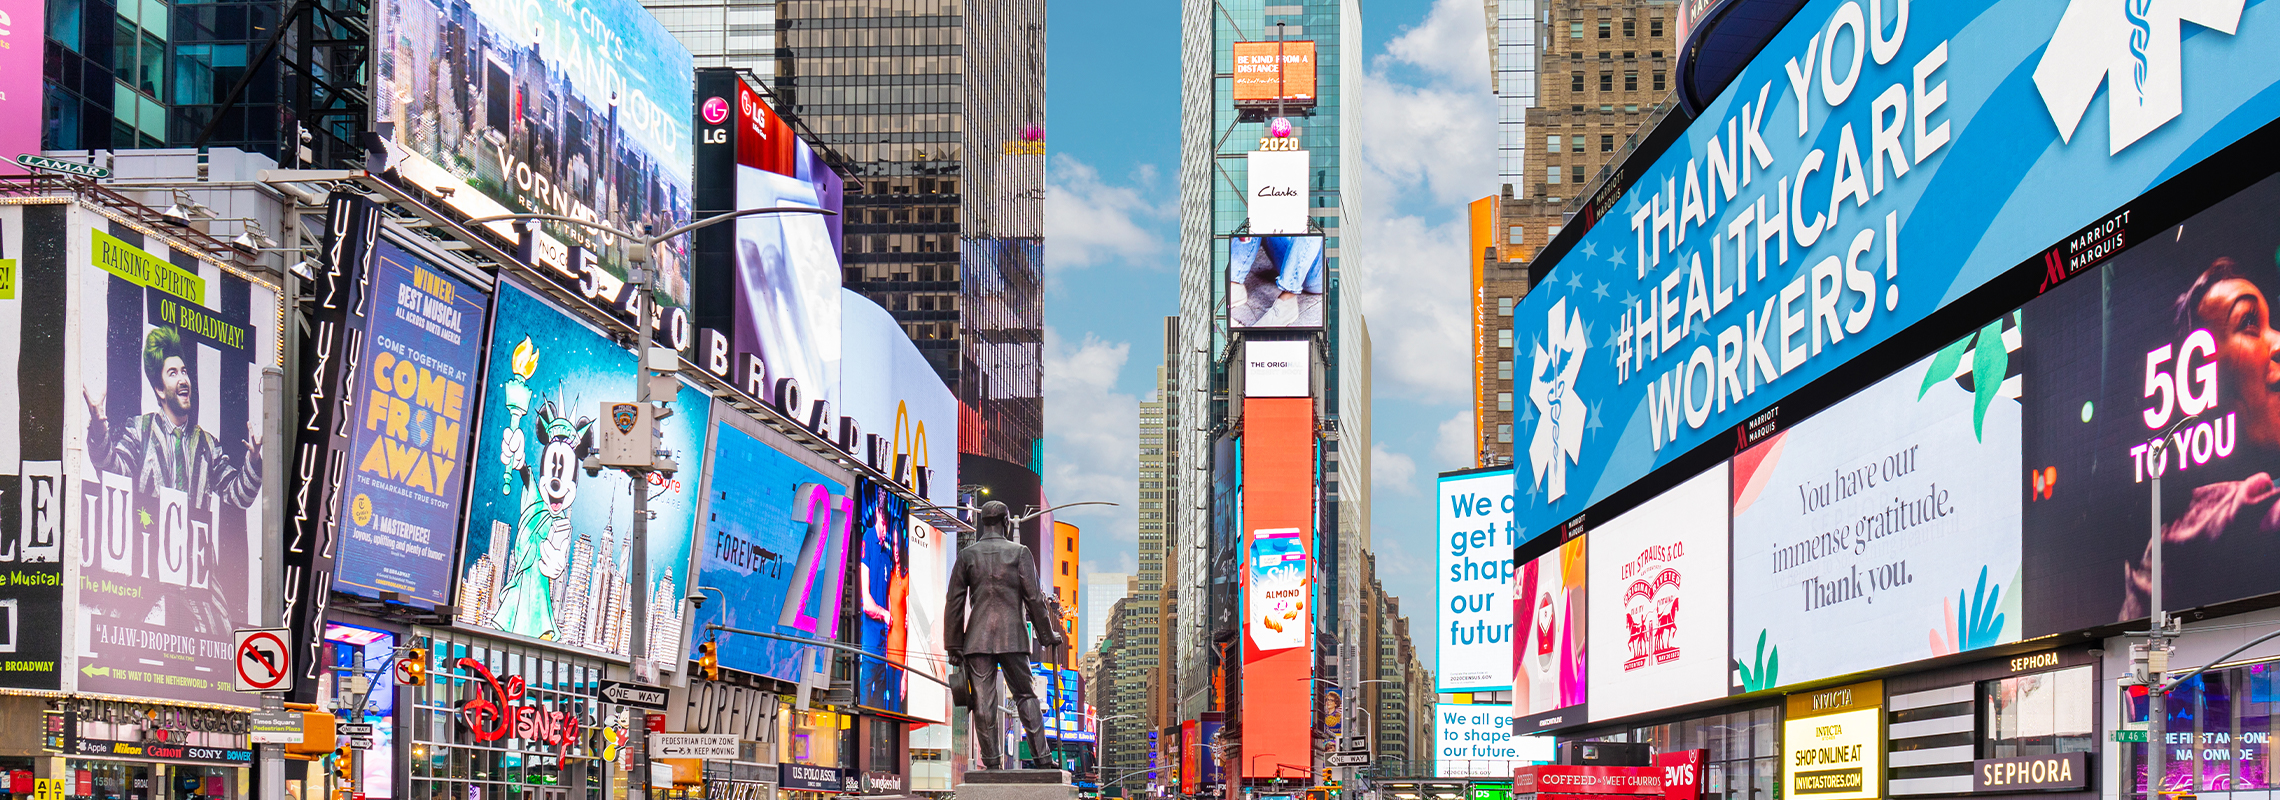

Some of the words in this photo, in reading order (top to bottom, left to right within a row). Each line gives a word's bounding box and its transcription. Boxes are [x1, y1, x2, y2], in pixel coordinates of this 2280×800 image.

[580, 7, 623, 62] CITY'S
[1238, 56, 1249, 64] BE
[1252, 55, 1273, 64] KIND
[1276, 55, 1299, 63] FROM
[1302, 55, 1308, 63] A
[1238, 64, 1279, 73] DISTANCE
[555, 19, 676, 153] LANDLORD
[752, 101, 766, 128] LG
[703, 128, 727, 144] LG
[1260, 137, 1299, 151] 2020
[1631, 80, 1774, 281] THANK
[1785, 0, 1910, 138] YOU
[25, 156, 101, 177] LAMAR
[1257, 186, 1298, 198] Clarks
[1596, 169, 1624, 205] MARRIOTT
[1596, 188, 1621, 220] MARQUIS
[1616, 39, 1951, 386] #HEALTHCARE
[564, 224, 597, 252] TRUST
[2069, 210, 2131, 254] MARRIOTT
[2070, 233, 2124, 272] MARQUIS
[102, 241, 150, 281] RAISING
[154, 268, 196, 301] SPIRITS
[414, 265, 455, 304] WINNER!
[398, 283, 422, 313] BEST
[423, 295, 461, 333] MUSICAL
[161, 299, 176, 323] ON
[180, 305, 244, 350] BROADWAY!
[396, 307, 405, 321] ALL
[405, 312, 424, 331] ACROSS
[425, 321, 441, 336] NORTH
[441, 328, 461, 346] AMERICA
[1647, 210, 1900, 452] WORKERS!
[378, 335, 404, 355] COME
[408, 348, 454, 376] TOGETHER
[456, 368, 467, 382] AT
[374, 352, 464, 421] COME
[2143, 327, 2218, 430] 5G
[704, 329, 934, 499] BROADWAY
[1749, 406, 1779, 430] MARRIOTT
[1749, 421, 1775, 442] MARQUIS
[2130, 437, 2168, 482] TO
[2173, 412, 2236, 471] YOU
[359, 435, 455, 497] AWAY
[357, 475, 370, 485] THE
[371, 479, 413, 498] REMARKABLE
[414, 493, 429, 504] TRUE
[430, 496, 450, 510] STORY
[1799, 479, 1830, 516] You
[1835, 461, 1877, 503] have
[1883, 444, 1919, 482] our
[1451, 493, 1492, 519] We
[380, 515, 431, 545] MASTERPIECE!
[1451, 522, 1496, 557] get
[1773, 525, 1850, 574] immense
[1855, 482, 1954, 556] gratitude.
[352, 528, 373, 545] Joyous,
[373, 532, 396, 550] uplifting
[396, 540, 406, 552] and
[406, 541, 421, 557] plenty
[716, 531, 767, 575] FOREVER
[771, 554, 782, 580] 21
[784, 483, 854, 640] 21
[1266, 563, 1301, 583] Silk
[1450, 556, 1514, 584] shap
[1621, 561, 1635, 580] LEVI
[1637, 544, 1665, 573] STRAUSS
[1667, 546, 1672, 562] &
[1673, 541, 1685, 559] CO.
[10, 570, 64, 587] Musical.
[80, 576, 99, 591] The
[102, 580, 144, 600] Musical.
[1802, 564, 1864, 612] Thank
[1867, 559, 1913, 605] you.
[1266, 588, 1299, 600] ALMOND
[1450, 592, 1494, 614] our
[111, 627, 195, 656] JAW-DROPPING
[200, 640, 234, 661] FUNHO
[1450, 619, 1513, 646] futur
[5, 661, 54, 672] BROADWAY
[2011, 652, 2058, 672] SEPHORA
[113, 668, 127, 680] THIS
[128, 671, 142, 682] WAY
[143, 671, 152, 682] TO
[153, 673, 164, 684] THE
[165, 675, 208, 689] NETHERWORLD
[217, 681, 231, 692] 50TH
[609, 688, 629, 698] ONE
[639, 691, 660, 702] WAY
[1812, 689, 1853, 711] INVICTA
[685, 678, 779, 743] FOREVER
[1443, 712, 1467, 725] We
[1471, 713, 1489, 725] all
[1494, 715, 1513, 730] ge
[662, 737, 699, 745] PEDESTRIAN
[701, 737, 717, 745] FLOW
[1443, 728, 1459, 741] to
[1464, 729, 1511, 744] shape
[1816, 724, 1842, 737] INVICTA
[2118, 732, 2125, 740] W
[2129, 732, 2138, 740] 46
[87, 743, 107, 753] Apple
[113, 742, 143, 755] Nikon
[147, 745, 182, 759] Canon
[189, 748, 222, 759] SONY
[227, 750, 252, 762] BOWER
[1443, 747, 1467, 757] our
[1471, 744, 1519, 758] future.
[1795, 750, 1816, 766] SHOP
[1819, 746, 1849, 764] ONLINE
[1851, 744, 1862, 762] AT
[793, 767, 803, 779] U.S.
[804, 768, 820, 780] POLO
[820, 770, 836, 782] ASSN.
[871, 775, 892, 793] sunglass
[893, 776, 901, 790] hut
[1542, 774, 1597, 786] COFFEED
[1602, 775, 1625, 786] SWEET
[1628, 775, 1661, 787] CHURROS
[1796, 773, 1861, 790] INVICTASTORES.COM
[1984, 758, 2072, 786] SEPHORA
